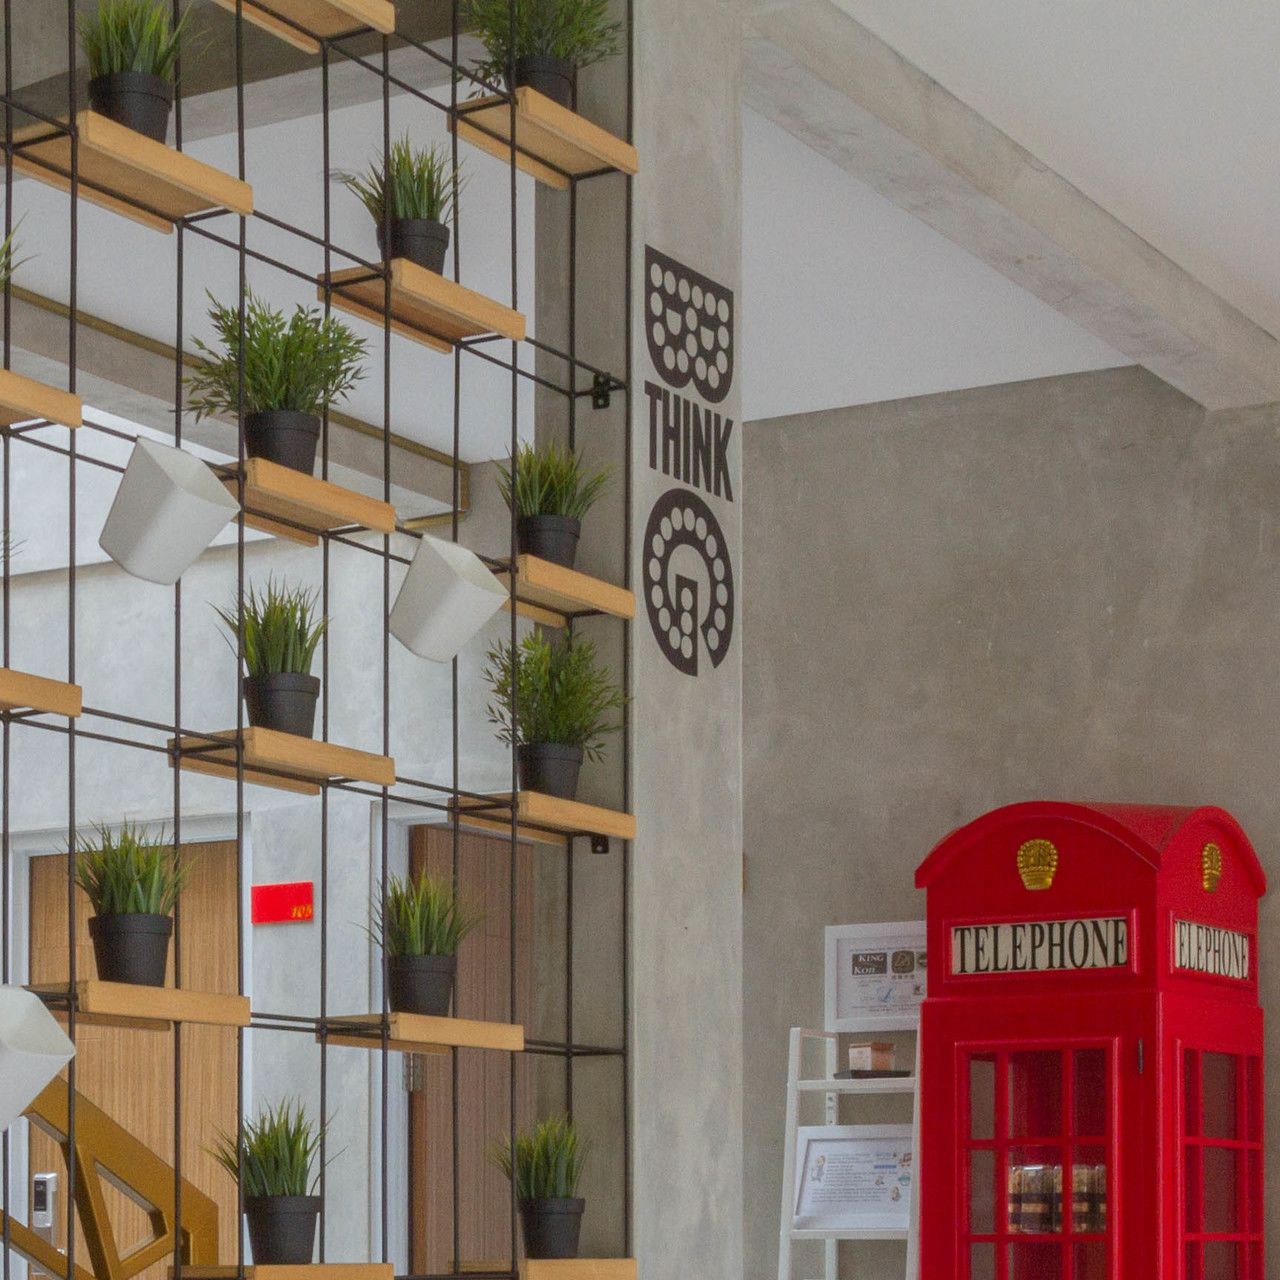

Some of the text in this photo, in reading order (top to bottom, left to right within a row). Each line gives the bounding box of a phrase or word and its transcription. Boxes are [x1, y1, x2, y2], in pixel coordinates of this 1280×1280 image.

[644, 380, 734, 502] THINK
[954, 918, 1127, 973] TELEPHONE
[1176, 921, 1248, 979] ELEPHONE
